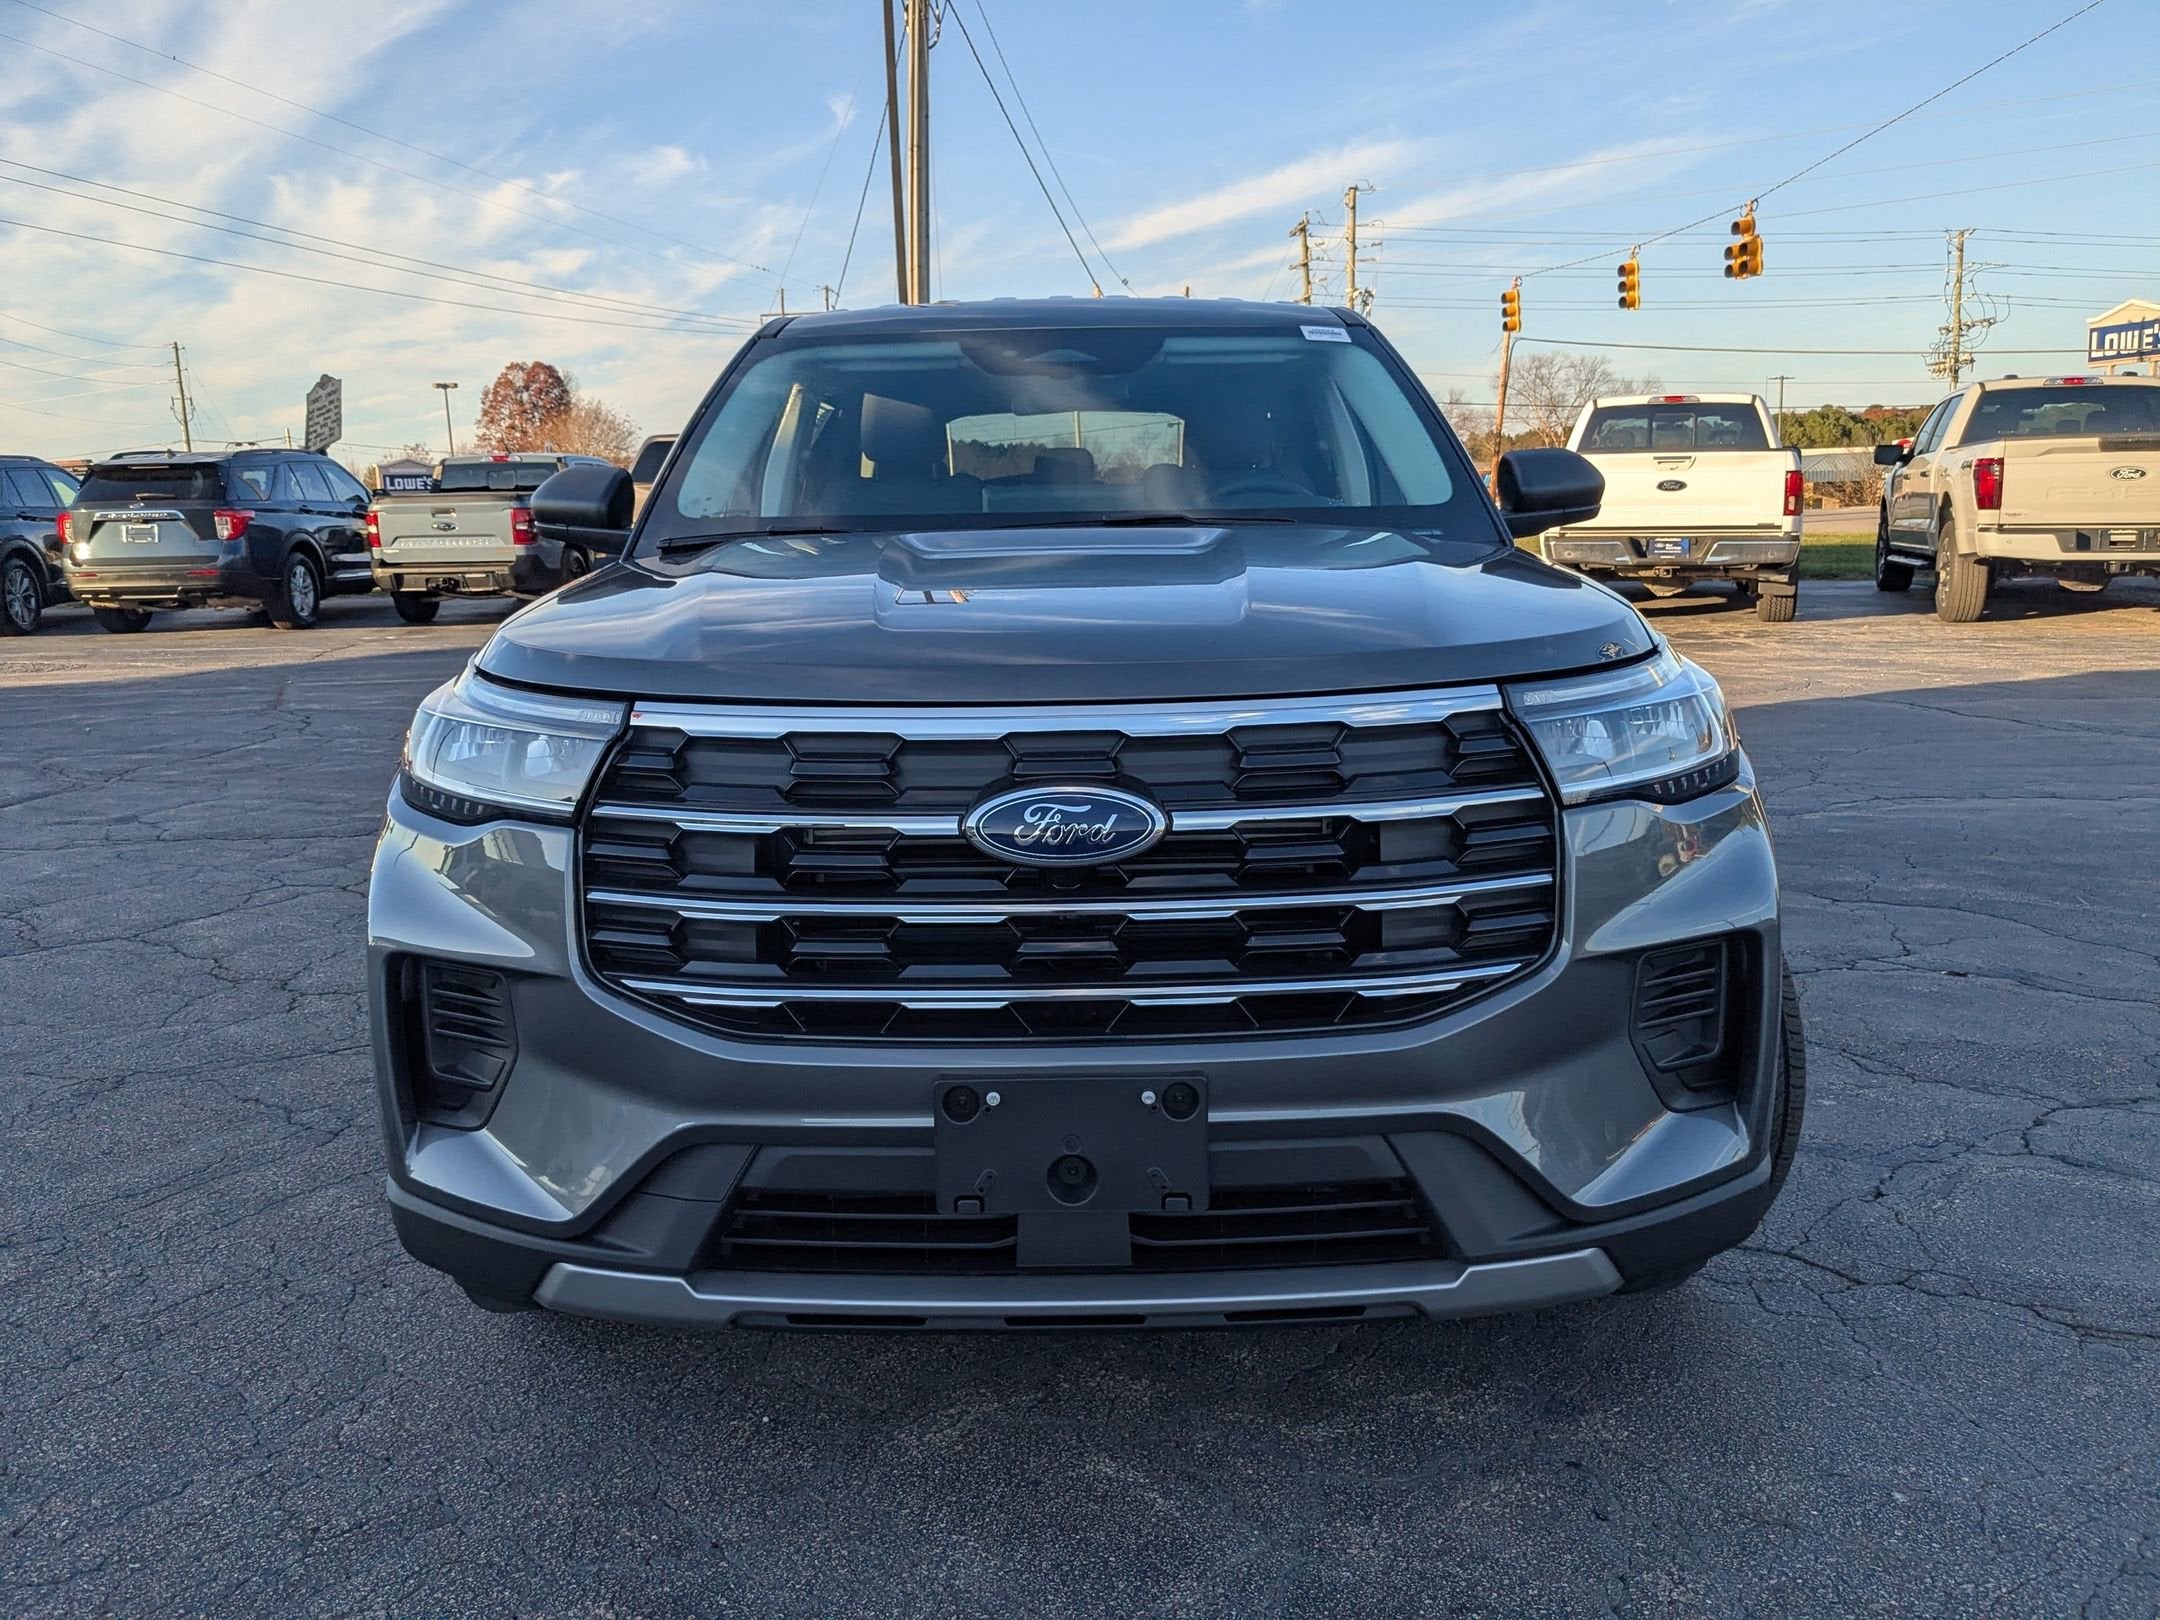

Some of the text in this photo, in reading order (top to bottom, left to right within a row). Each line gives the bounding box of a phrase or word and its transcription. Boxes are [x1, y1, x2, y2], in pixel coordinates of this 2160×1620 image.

[2091, 323, 2160, 358] LOWE'
[385, 476, 433, 490] LOWE'S
[2116, 468, 2142, 479] Ford
[1013, 802, 1119, 846] Ford
